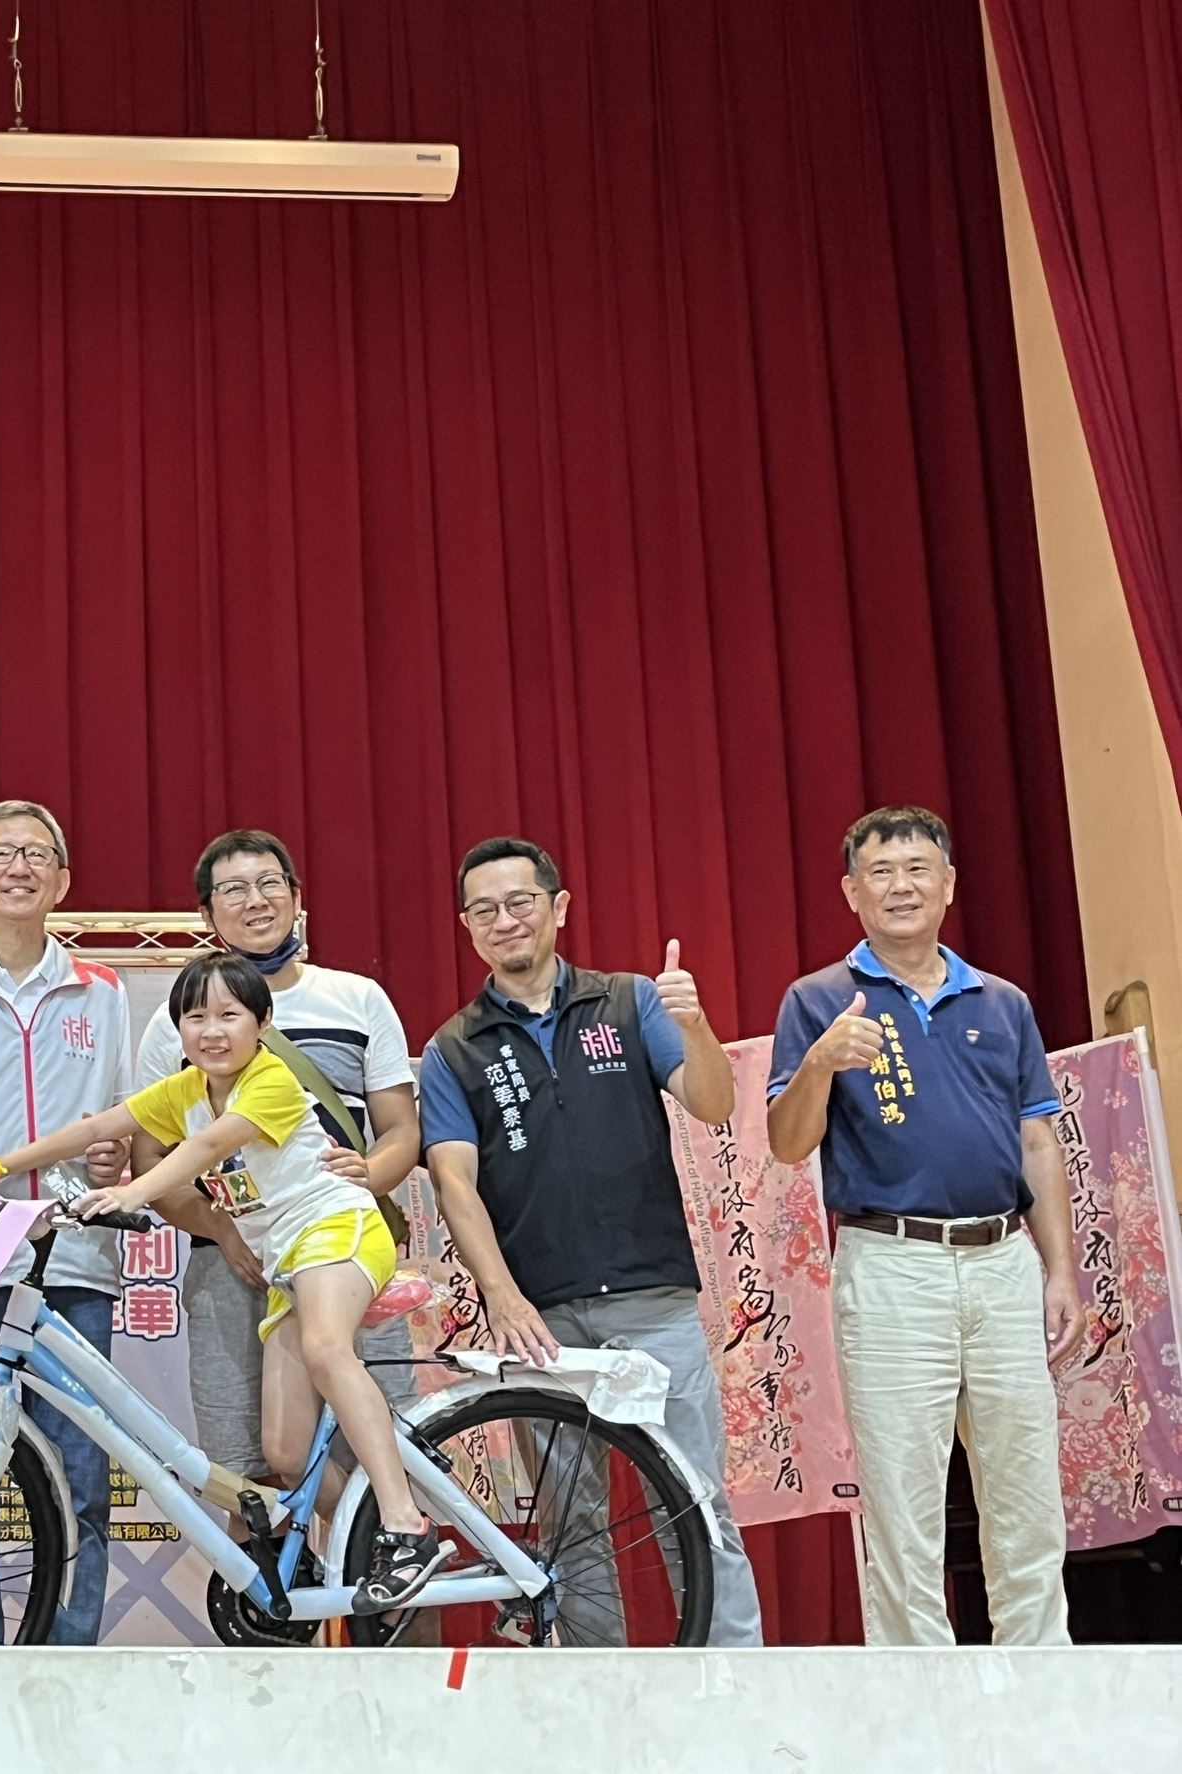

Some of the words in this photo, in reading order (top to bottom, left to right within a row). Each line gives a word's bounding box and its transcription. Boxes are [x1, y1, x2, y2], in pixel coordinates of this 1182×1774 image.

[499, 1044, 531, 1103] 客家局長
[484, 1063, 527, 1152] 范姜泰基
[688, 1167, 699, 1179] of
[691, 1181, 706, 1217] Hakka
[127, 1229, 173, 1275] 利
[707, 1262, 723, 1308] Taoyuan
[129, 1290, 174, 1336] 華
